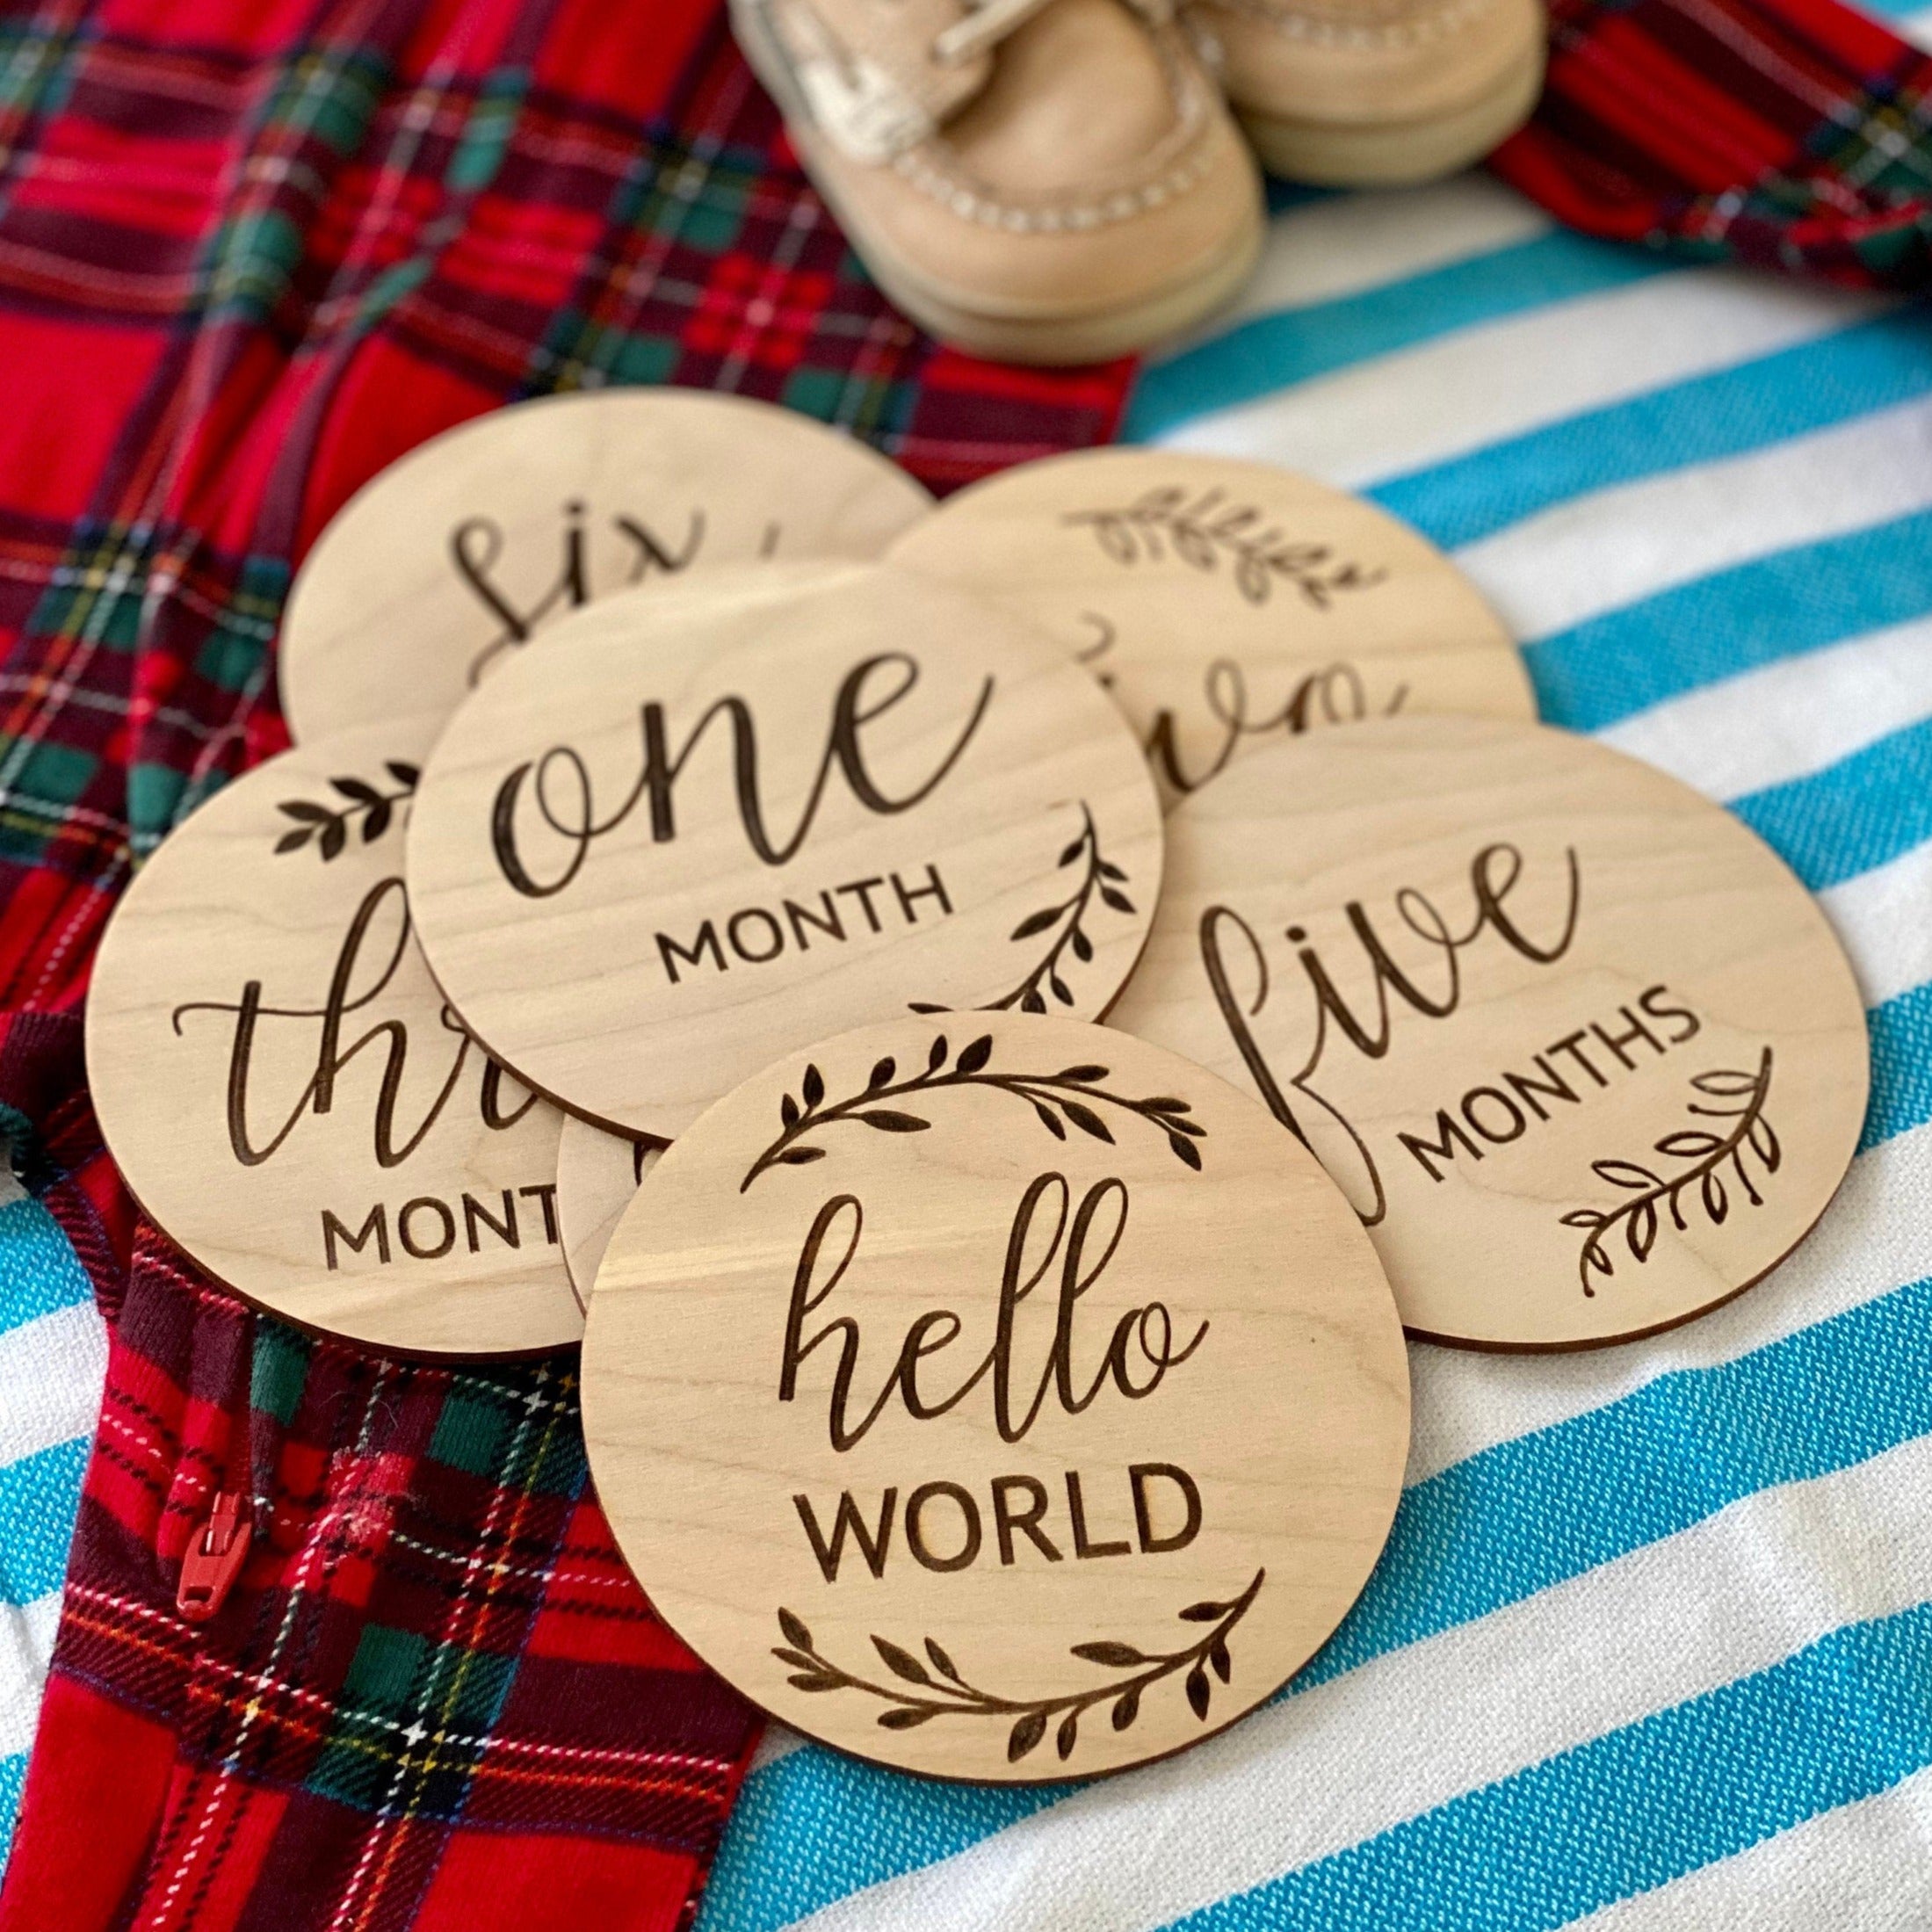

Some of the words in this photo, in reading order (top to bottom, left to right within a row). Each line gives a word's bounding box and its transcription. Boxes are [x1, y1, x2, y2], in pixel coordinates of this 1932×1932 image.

[449, 497, 783, 689] six
[492, 653, 995, 898] one
[655, 864, 953, 983] MONTH
[1199, 843, 1579, 1226] five
[1396, 986, 1700, 1182] MONTHS
[778, 1171, 1209, 1451] hello
[793, 1463, 1203, 1583] WORLD
